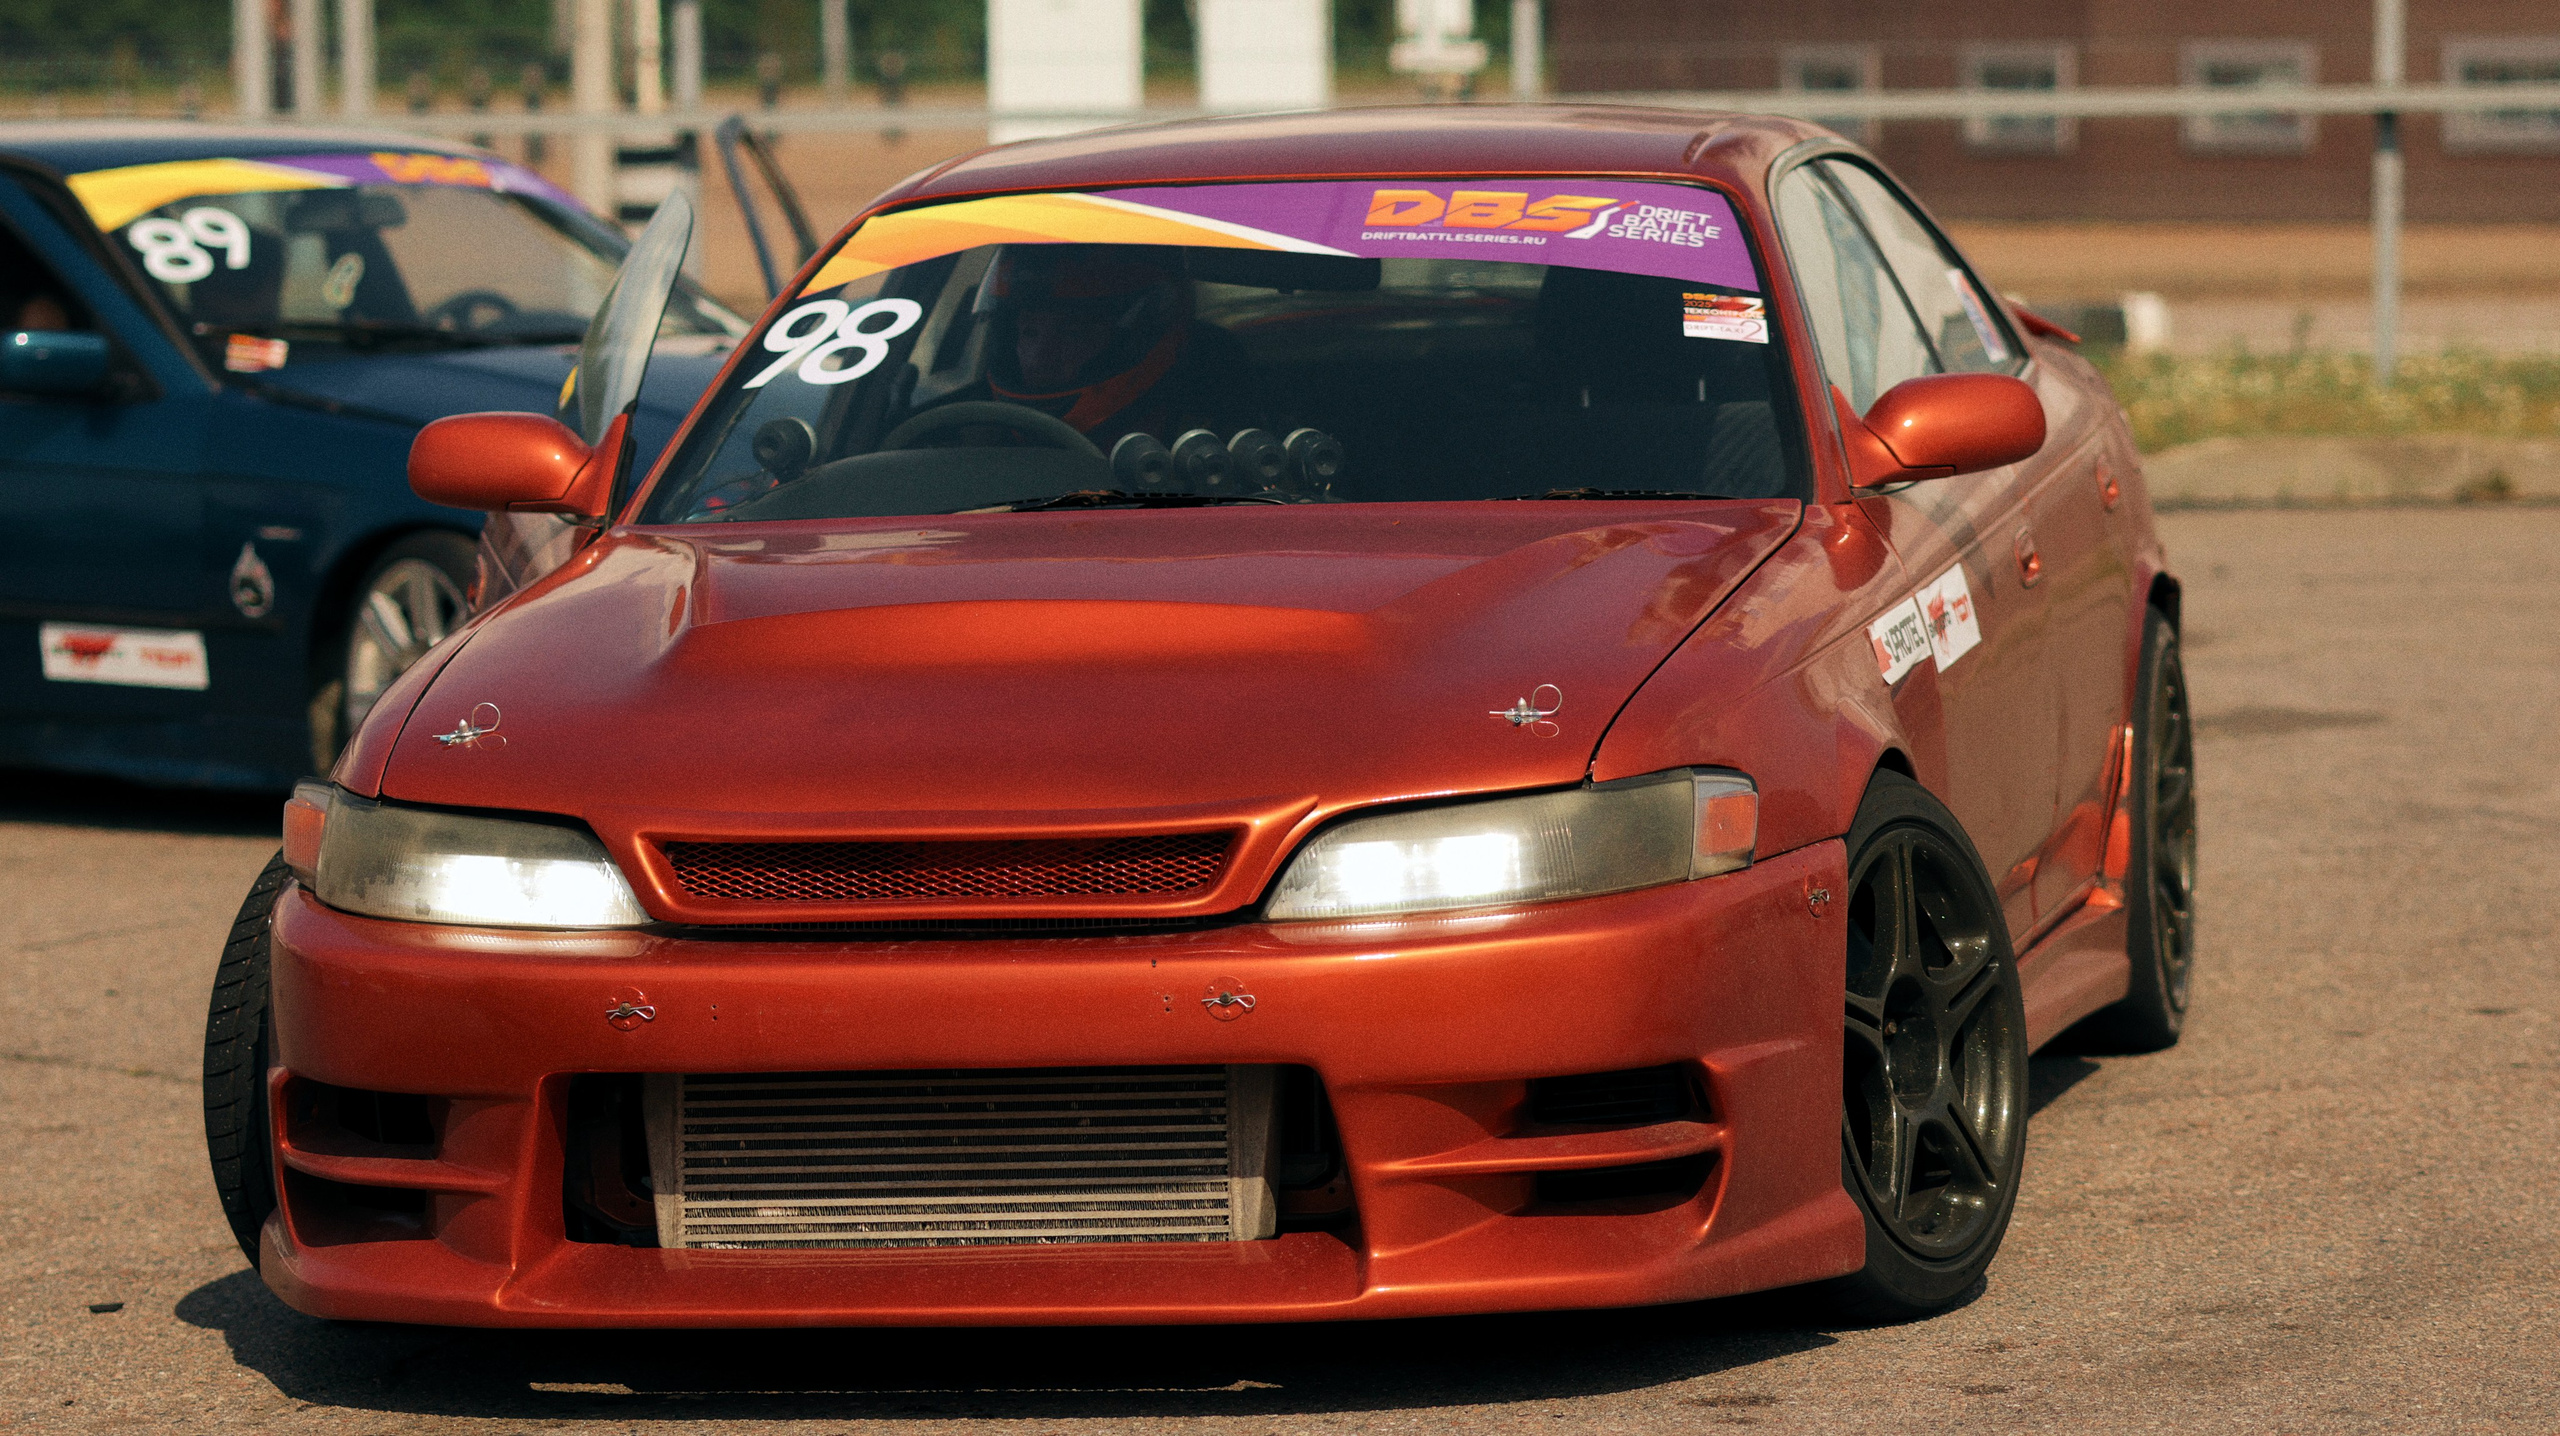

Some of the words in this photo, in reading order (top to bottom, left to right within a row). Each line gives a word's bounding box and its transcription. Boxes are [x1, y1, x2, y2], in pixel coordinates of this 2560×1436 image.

[1363, 189, 1620, 232] DBS
[1638, 204, 1713, 226] DRIFT
[1361, 231, 1547, 246] DRIFTBATTLESERIES.RU
[1607, 223, 1705, 248] SERIES
[1623, 213, 1722, 239] BATTLE
[128, 206, 251, 283] 89
[1683, 300, 1713, 308] 2025
[741, 297, 923, 390] 98
[1740, 320, 1764, 342] 2
